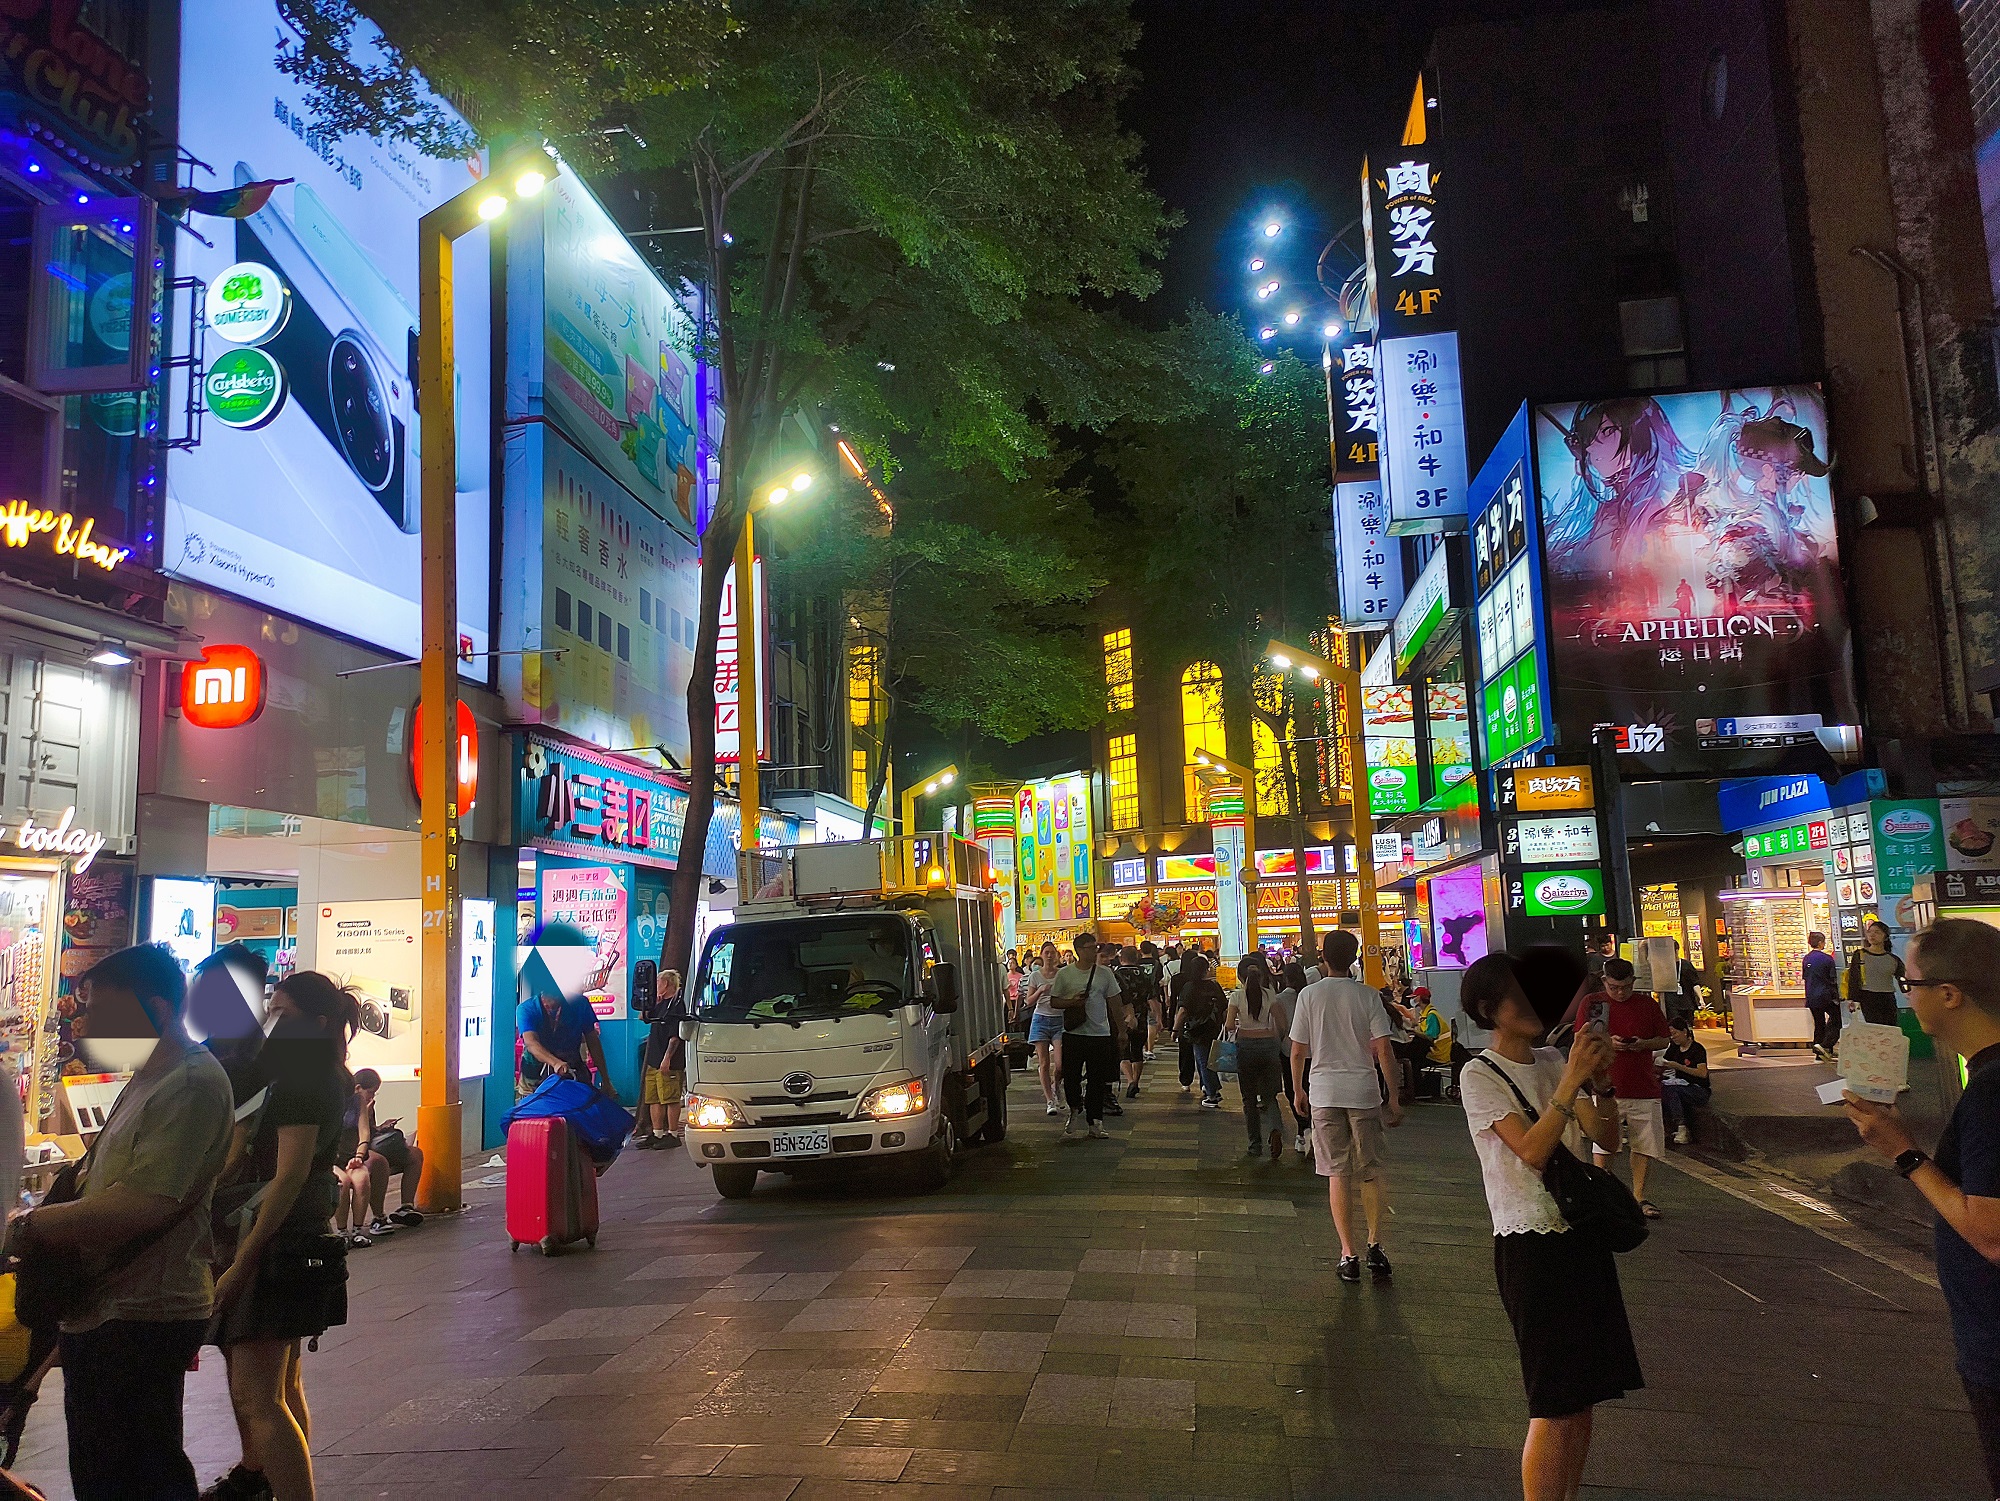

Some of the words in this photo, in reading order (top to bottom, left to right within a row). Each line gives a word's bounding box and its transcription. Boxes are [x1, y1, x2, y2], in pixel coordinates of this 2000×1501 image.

[1384, 196, 1409, 210] POWER
[1418, 195, 1437, 206] MEAT
[1394, 288, 1441, 316] 4F
[214, 308, 270, 326] SOMERSBY
[207, 369, 274, 396] Carlsberg
[1415, 488, 1449, 509] 3F
[75, 517, 125, 572] bar
[1363, 599, 1389, 614] 3F
[1619, 615, 1777, 642] APHELION
[1780, 780, 1809, 800] PLAZA
[18, 806, 107, 874] today
[1423, 817, 1440, 848] LUSH
[426, 875, 441, 892] H
[1975, 876, 2000, 886] AB
[552, 888, 617, 902] 週週有新品
[1541, 886, 1589, 902] Saizeriya
[423, 910, 445, 928] 27
[552, 909, 617, 923] 天天最低價
[773, 1134, 829, 1153] BSN-3263
